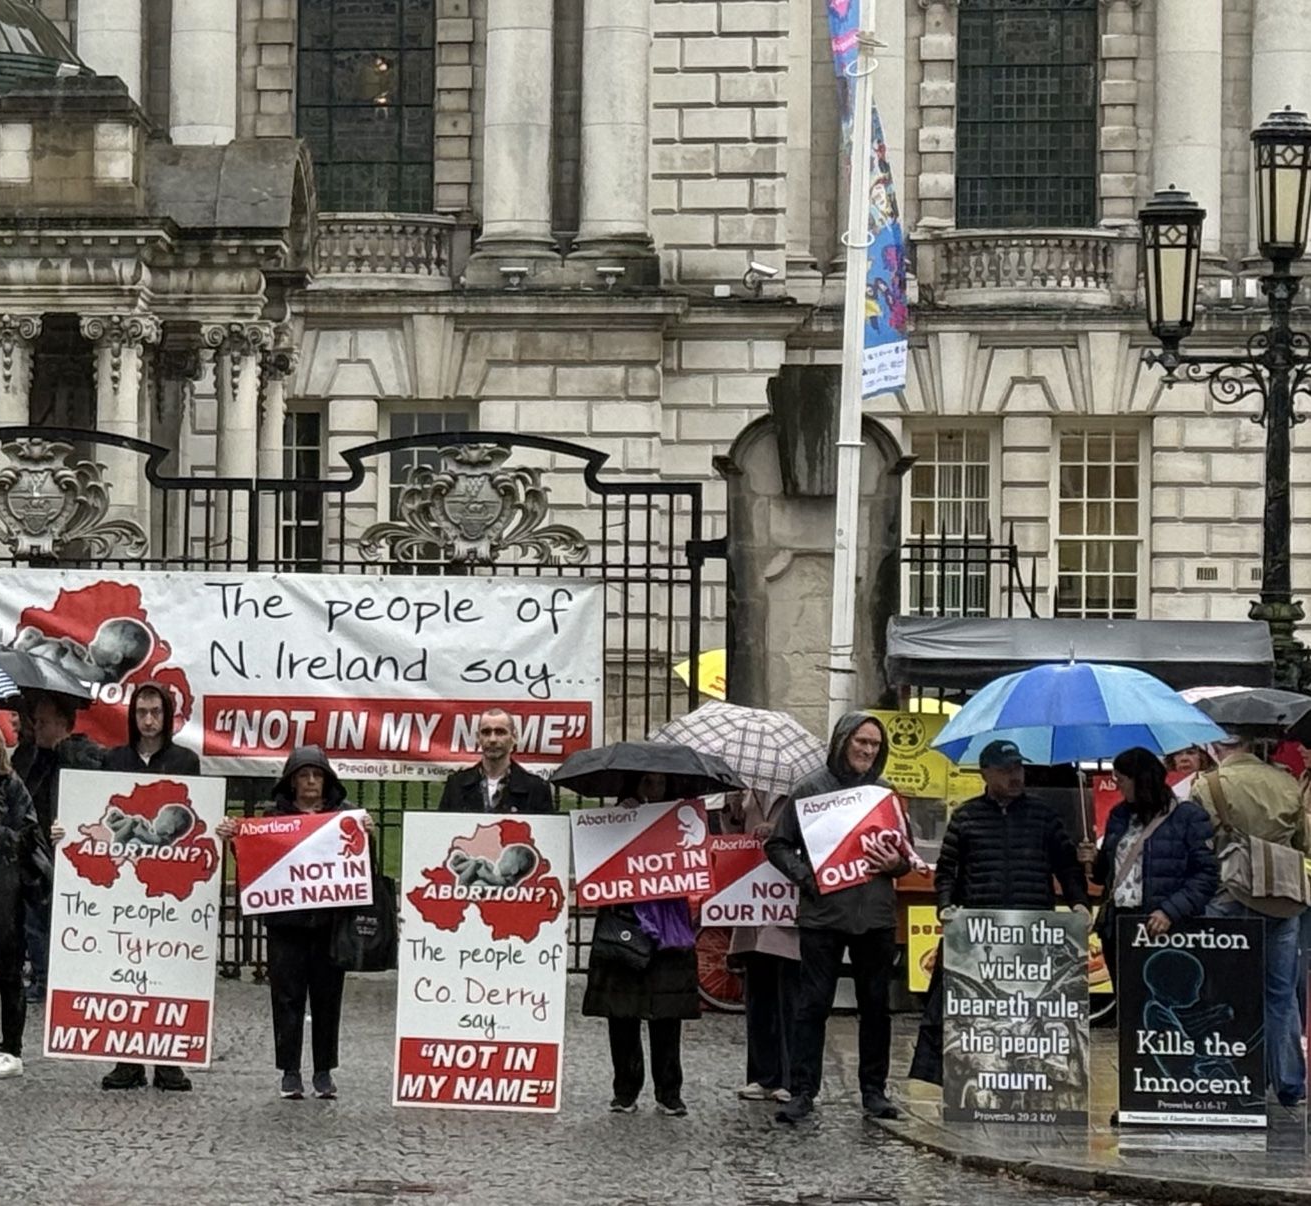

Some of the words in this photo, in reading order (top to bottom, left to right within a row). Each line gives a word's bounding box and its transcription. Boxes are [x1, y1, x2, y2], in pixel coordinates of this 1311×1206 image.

[204, 581, 293, 620] The
[324, 589, 485, 635] people
[516, 588, 573, 635] of
[209, 639, 261, 680] N.
[276, 640, 428, 683] Ireland
[214, 708, 316, 751] “NOT
[325, 710, 369, 751] IN
[378, 711, 442, 753] MY
[449, 713, 587, 755] NME”
[392, 763, 415, 775] Life
[802, 791, 863, 817] Abortion?
[239, 819, 302, 837] Abortion?
[576, 810, 639, 827] Abortion?
[78, 840, 202, 863] ABORTION?
[626, 851, 678, 875] NOT
[682, 849, 708, 869] IN
[288, 862, 336, 883] NOT
[343, 860, 367, 880] IN
[246, 888, 295, 909] OUR
[300, 883, 368, 904] NAME
[422, 883, 548, 903] ABORTION?
[581, 879, 635, 902] OUR
[639, 871, 710, 896] NAME
[752, 881, 796, 900] NOT
[60, 891, 101, 917] The
[112, 901, 179, 928] people
[191, 903, 216, 931] of
[706, 904, 755, 921] OUR
[761, 904, 800, 922] NA
[61, 926, 102, 954] Co.
[107, 929, 210, 964] Tyrone
[967, 917, 1025, 945] When
[1031, 919, 1065, 945] the
[1131, 922, 1251, 950] Abortion
[407, 936, 447, 962] The
[458, 943, 526, 971] people
[538, 944, 563, 972] of
[979, 955, 1053, 982] wicked
[71, 995, 149, 1024] “NOT
[154, 1002, 189, 1028] IN
[414, 976, 456, 1004] Co.
[464, 976, 550, 1022] Derry
[946, 990, 1030, 1017] beareth
[1036, 992, 1085, 1021] rule,
[51, 1025, 100, 1051] MY
[104, 1030, 206, 1059] NAME”
[960, 1026, 995, 1053] the
[1001, 1029, 1071, 1060] people
[1135, 1029, 1195, 1056] Kills
[1204, 1031, 1248, 1057] the
[420, 1042, 498, 1071] “NOT
[503, 1047, 538, 1072] IN
[399, 1073, 449, 1100] MY
[452, 1075, 554, 1104] NAME”
[977, 1071, 1054, 1092] mourn.
[1133, 1067, 1252, 1096] Innocent
[973, 1110, 1016, 1122] Proverbs
[1040, 1112, 1057, 1123] KJV
[1157, 1099, 1194, 1110] Proverbs
